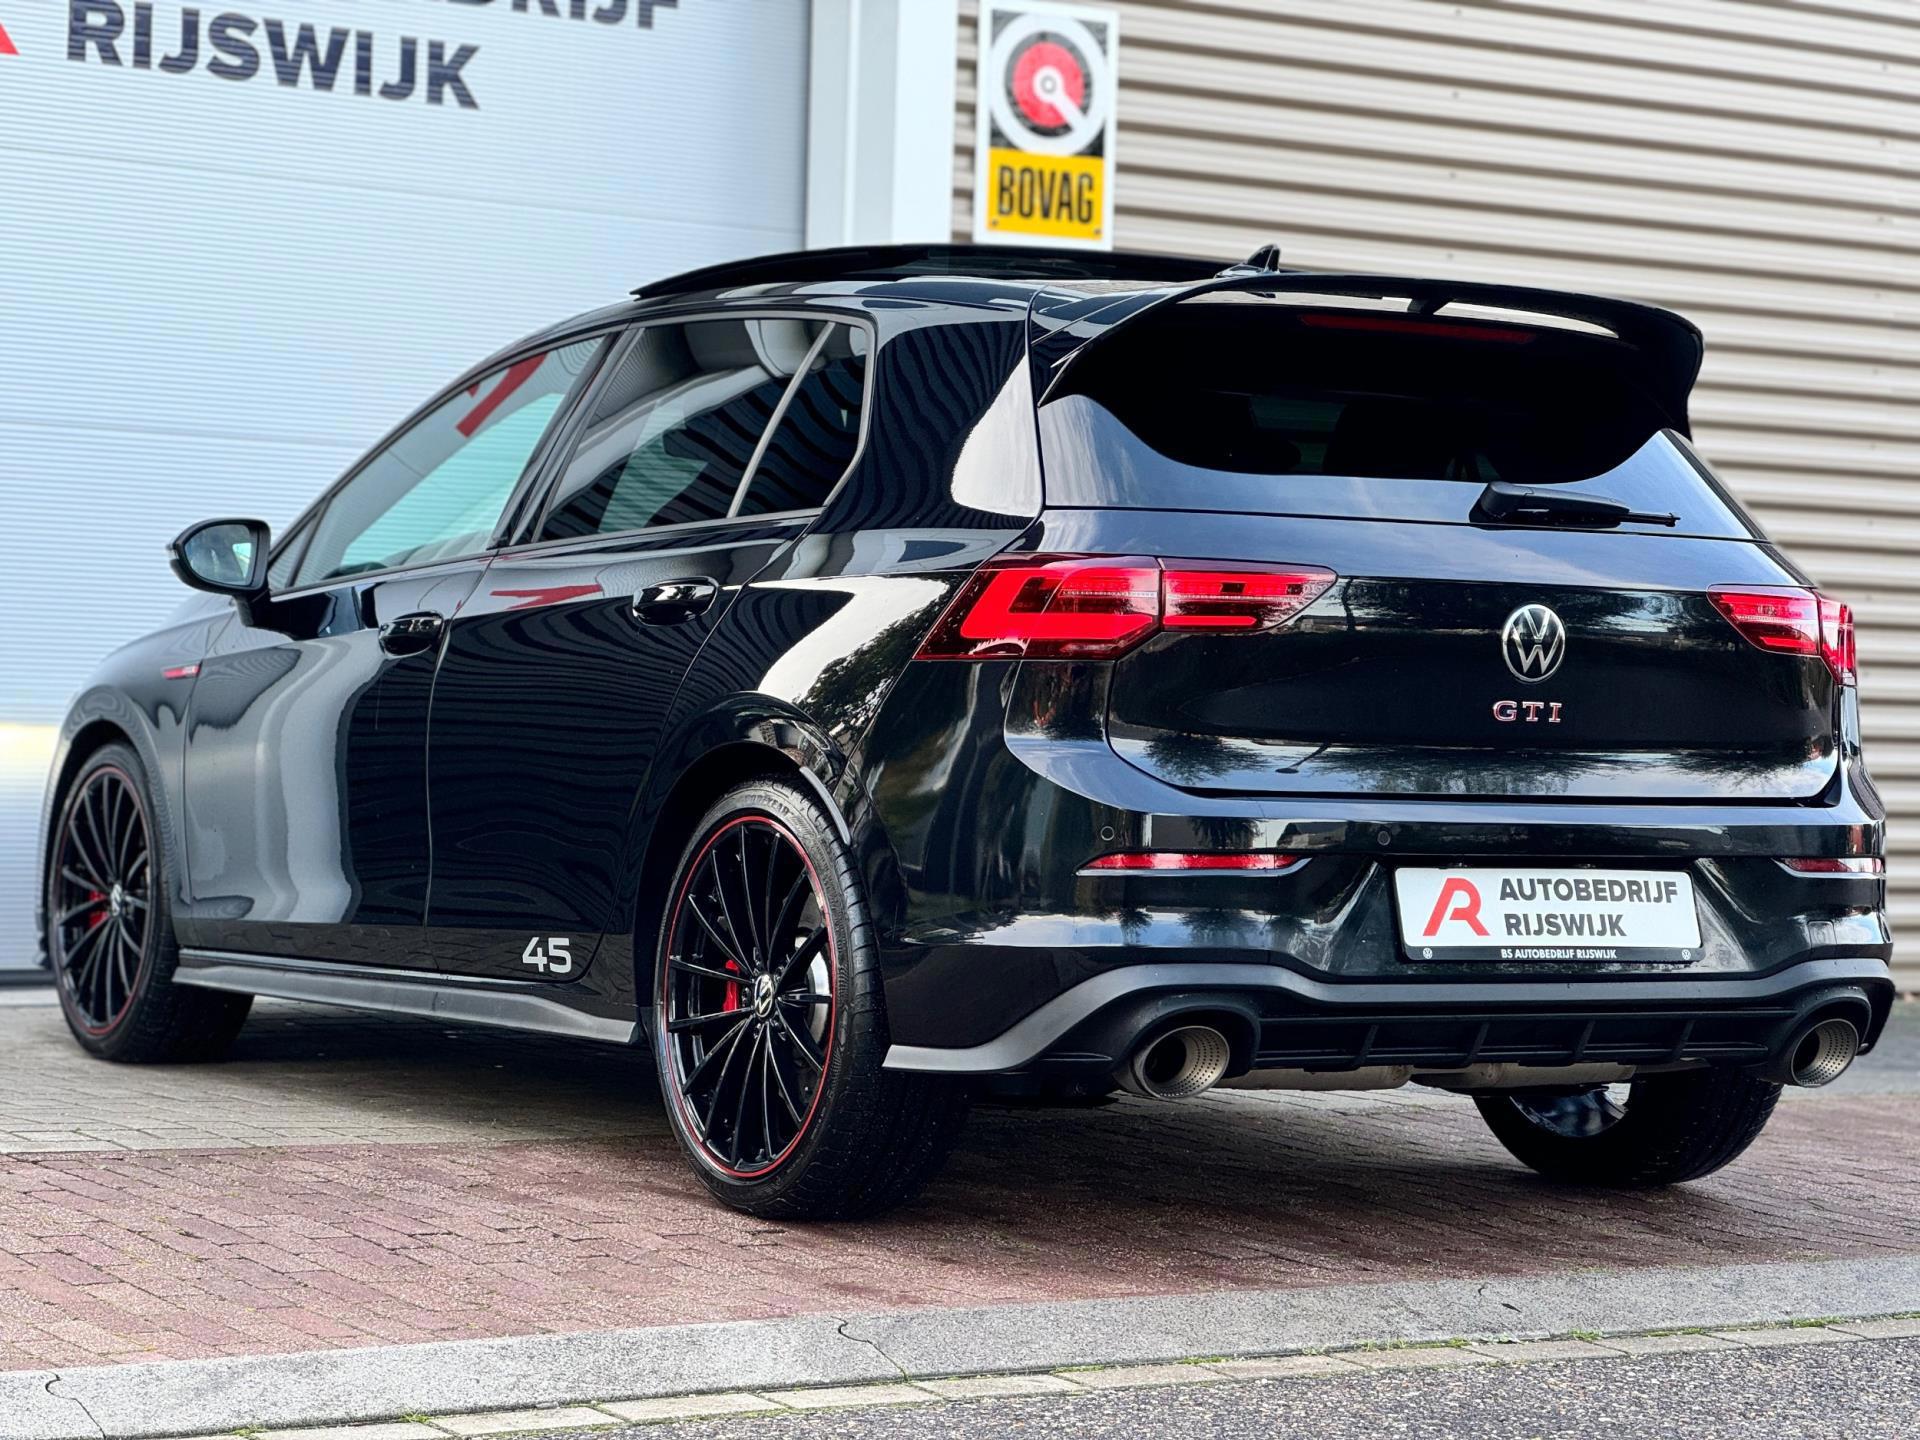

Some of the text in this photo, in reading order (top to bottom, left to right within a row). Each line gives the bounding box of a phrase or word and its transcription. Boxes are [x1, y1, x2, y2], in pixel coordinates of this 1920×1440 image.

[67, 0, 480, 110] RIJSWIJK
[999, 165, 1094, 225] BOVAG
[1493, 700, 1563, 723] GTI
[1499, 878, 1678, 904] AUTOBEDRIJF
[1503, 913, 1627, 937] RIJSWIJK
[522, 936, 572, 973] 45
[1501, 948, 1617, 959] BS AUTOBEDRIJF RIJSWIJK
